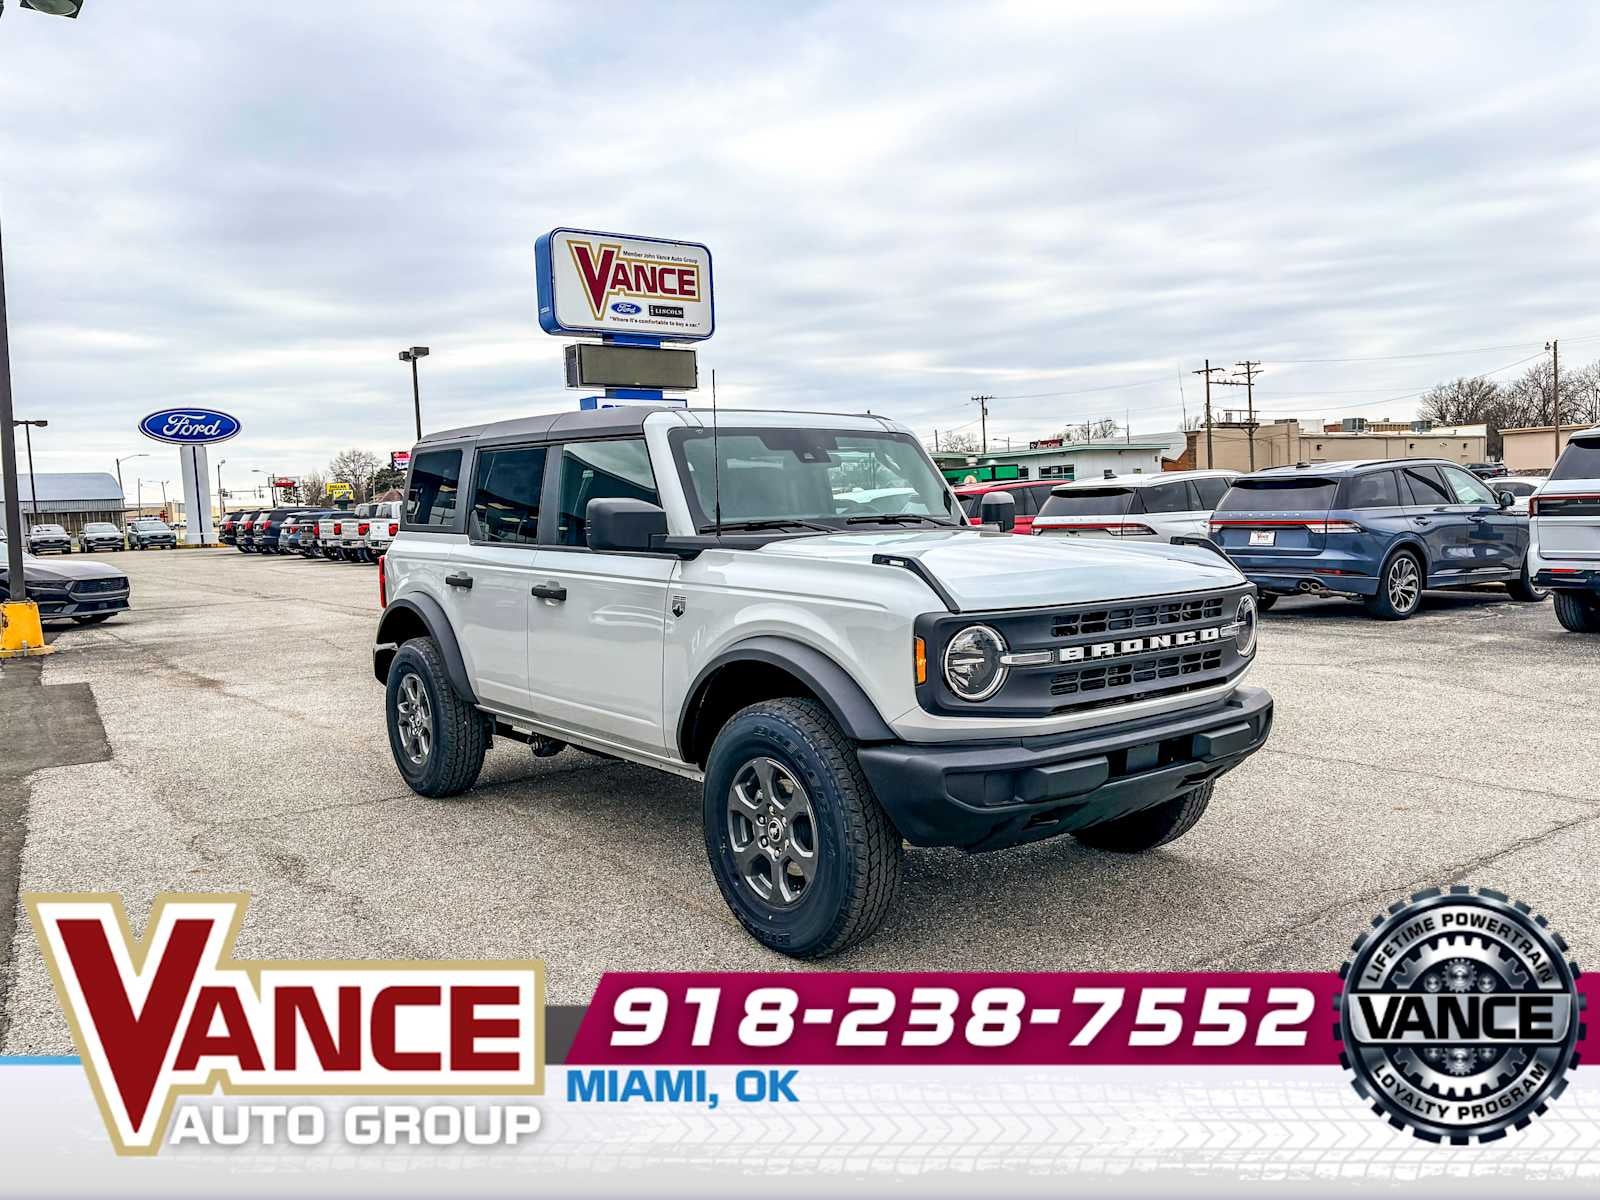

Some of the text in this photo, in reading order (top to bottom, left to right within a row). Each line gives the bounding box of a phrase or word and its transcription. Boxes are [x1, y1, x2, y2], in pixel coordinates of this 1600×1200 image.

[573, 245, 697, 316] VANCE
[617, 304, 636, 314] Ford
[655, 308, 683, 316] LINCOLN
[162, 413, 222, 436] Ford
[1059, 627, 1219, 662] BRONCO
